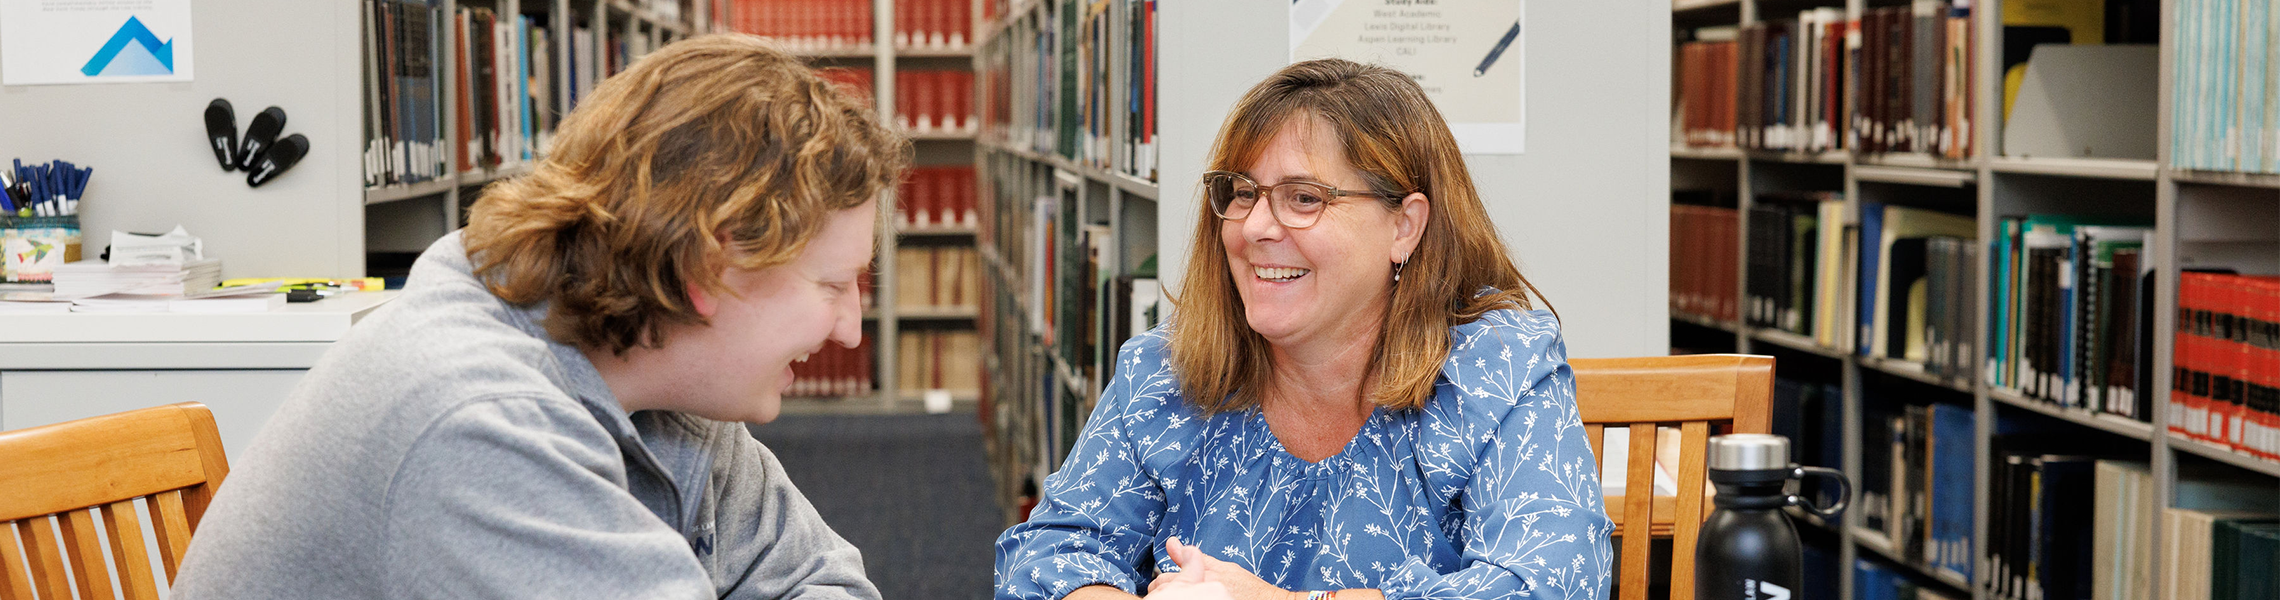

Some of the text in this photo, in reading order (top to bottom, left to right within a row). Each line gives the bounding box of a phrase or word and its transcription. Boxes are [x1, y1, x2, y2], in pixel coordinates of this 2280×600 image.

[1373, 9, 1442, 18] West Academic
[1389, 22, 1418, 33] Digital
[1420, 22, 1450, 32] Library
[1358, 35, 1458, 44] Aspen Learning Library
